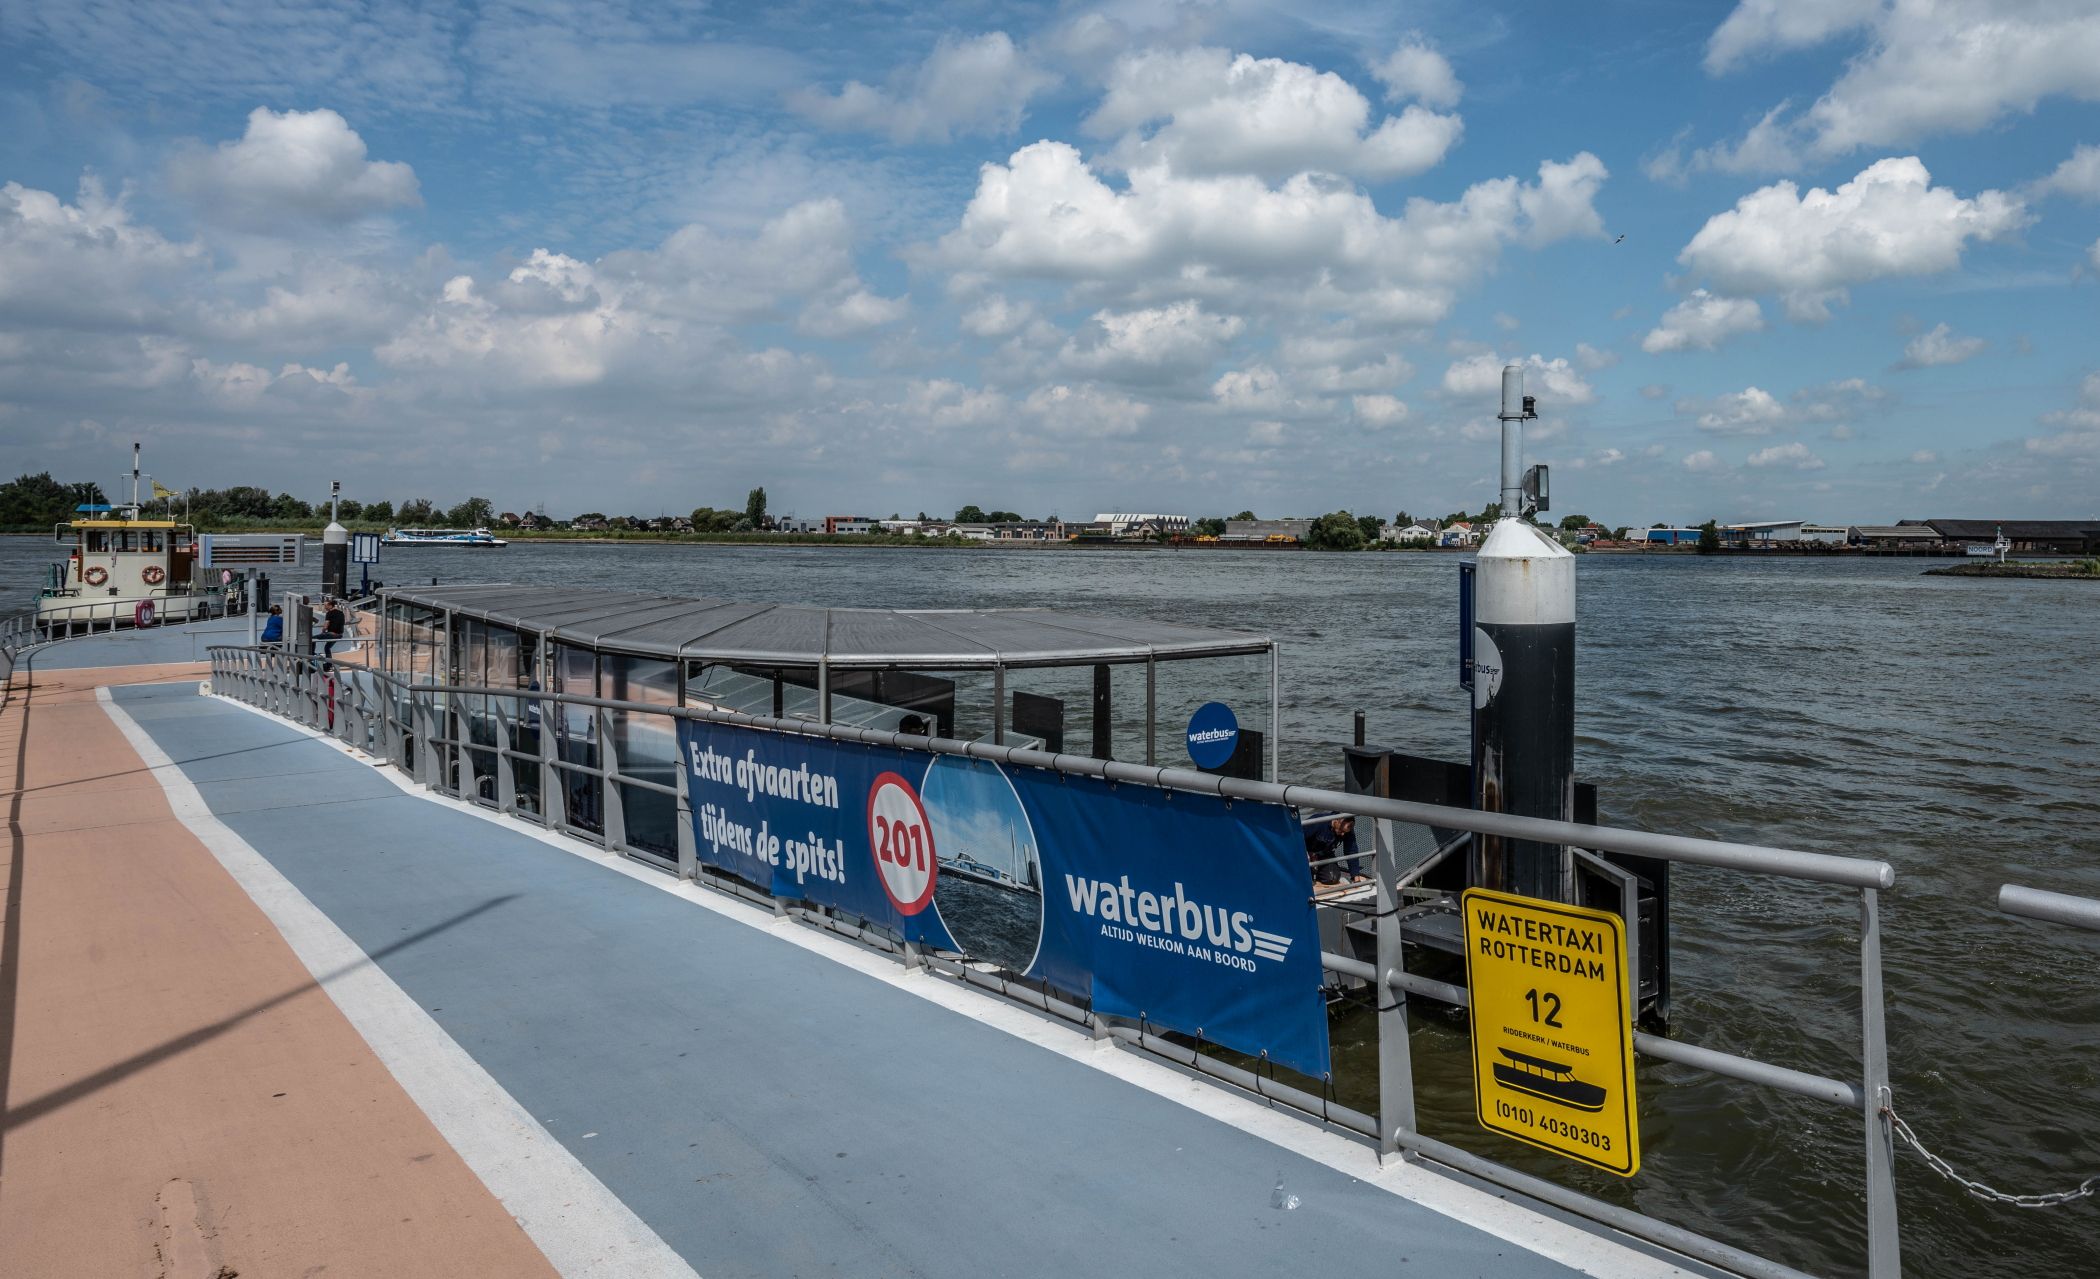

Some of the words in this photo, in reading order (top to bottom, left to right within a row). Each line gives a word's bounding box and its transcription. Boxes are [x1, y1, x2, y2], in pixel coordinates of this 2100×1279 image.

[1189, 728, 1229, 742] waterbus
[690, 741, 733, 785] Extra
[736, 749, 839, 809] afvaarten
[701, 803, 753, 855] tijdens
[756, 820, 780, 866] de
[785, 831, 846, 884] spits!
[876, 815, 926, 872] 201
[1101, 924, 1134, 942] ALTIJD
[1136, 932, 1184, 955] WELKOM
[1187, 945, 1211, 962] AAN
[1215, 951, 1256, 973] BOORD
[1477, 908, 1603, 955] WATERTAXI
[1480, 937, 1605, 981] ROTTERDAM
[1525, 988, 1563, 1029] 12
[1503, 1026, 1545, 1044] RIDDERKERK
[1551, 1039, 1590, 1056] WATERBUS
[1496, 1099, 1534, 1127] (010)
[1539, 1115, 1611, 1151] 4030303
